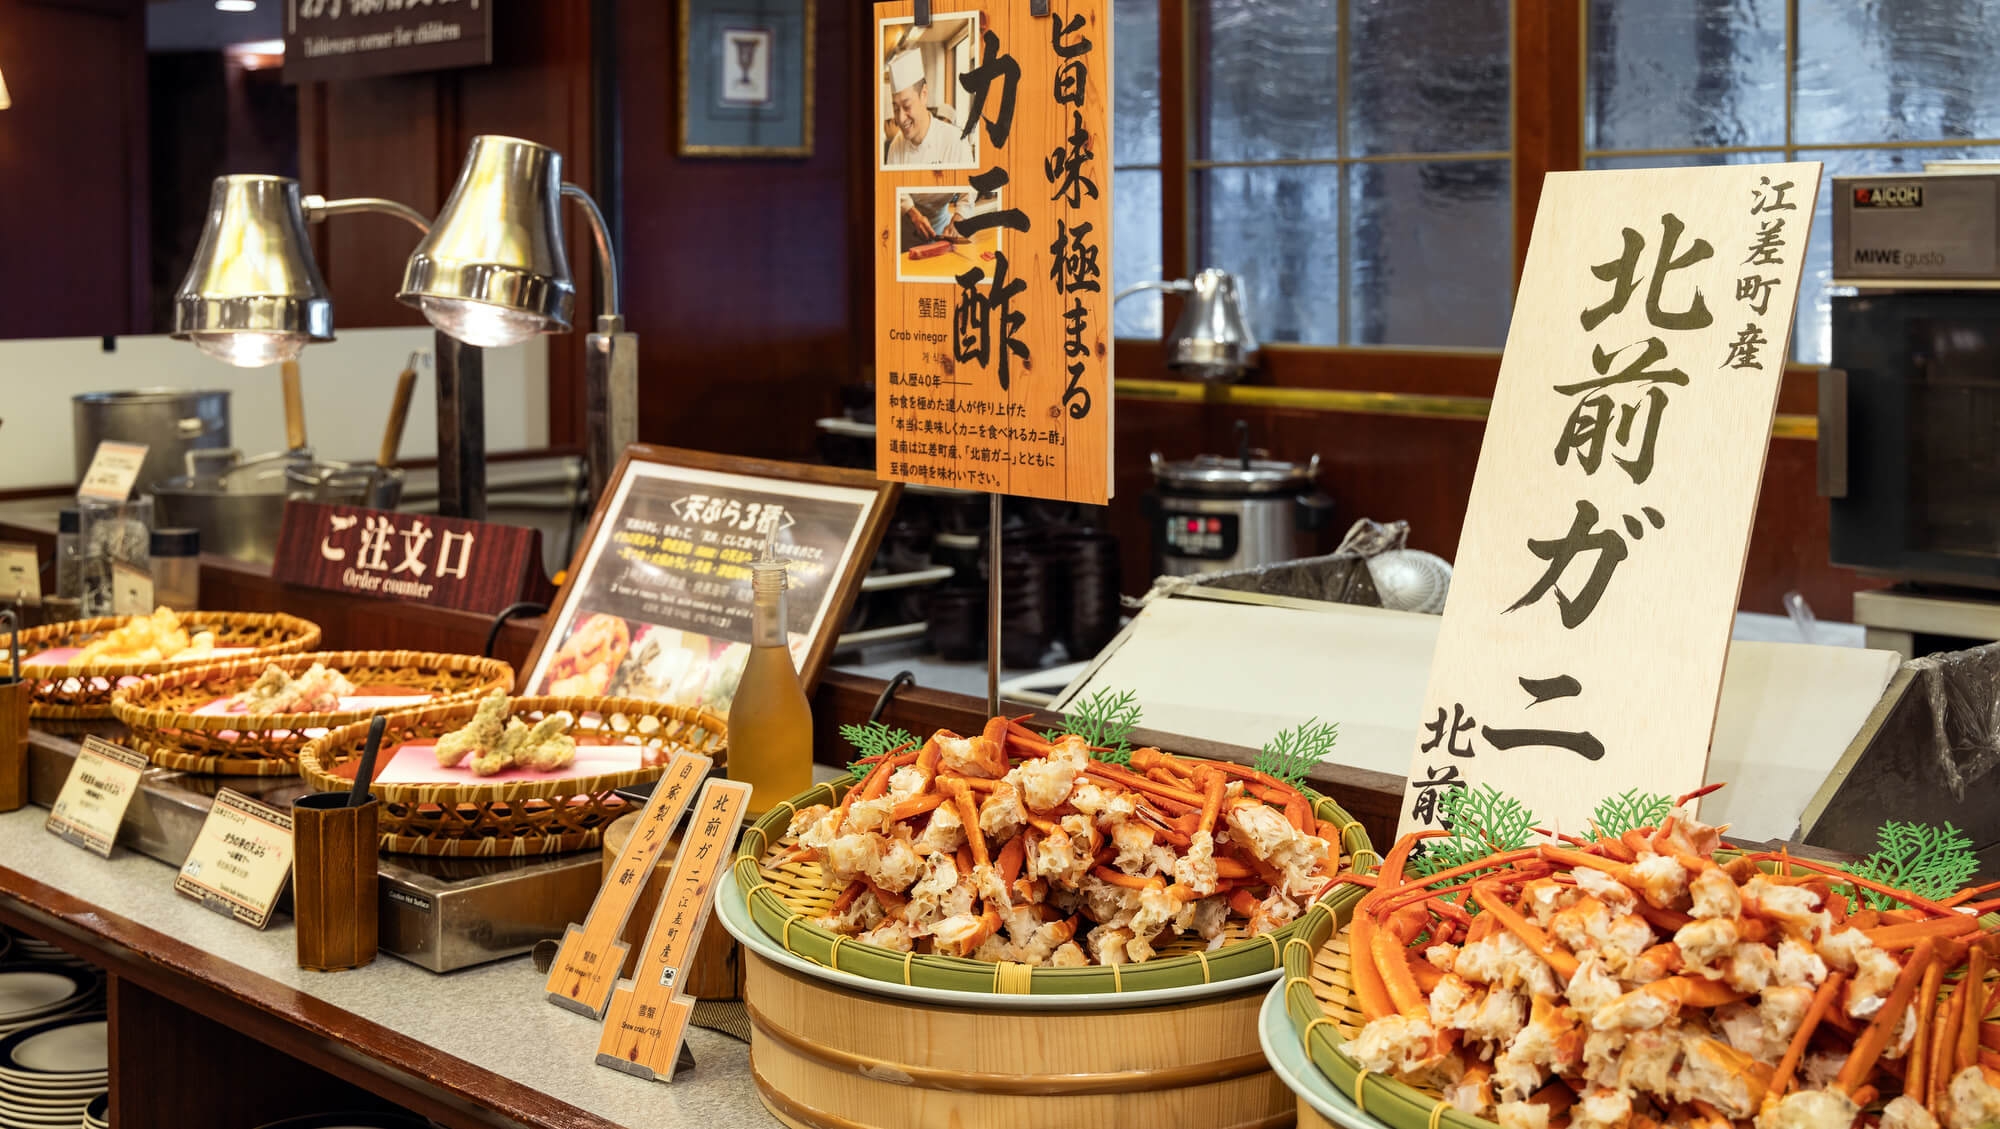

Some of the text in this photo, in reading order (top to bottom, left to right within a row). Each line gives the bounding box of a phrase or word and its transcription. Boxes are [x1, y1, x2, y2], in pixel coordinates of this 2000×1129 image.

[953, 30, 1031, 392] カニ酢
[1045, 12, 1101, 420] 旨味極まる
[1718, 176, 1797, 370] 江差町産
[1854, 248, 1945, 269] MIWE gusto
[889, 328, 949, 345] Crab vinegar
[889, 394, 1027, 418] 和食を極めた達人が作り上げた
[889, 461, 1001, 487] 至福の時を味わい下さい。
[1481, 213, 1714, 761] 北前ガニ
[321, 513, 475, 580] ご注文口
[343, 567, 434, 599] Order counter
[1408, 702, 1477, 862] 北前
[619, 762, 693, 886] 自家製カニ酢
[621, 1021, 633, 1032] Snow
